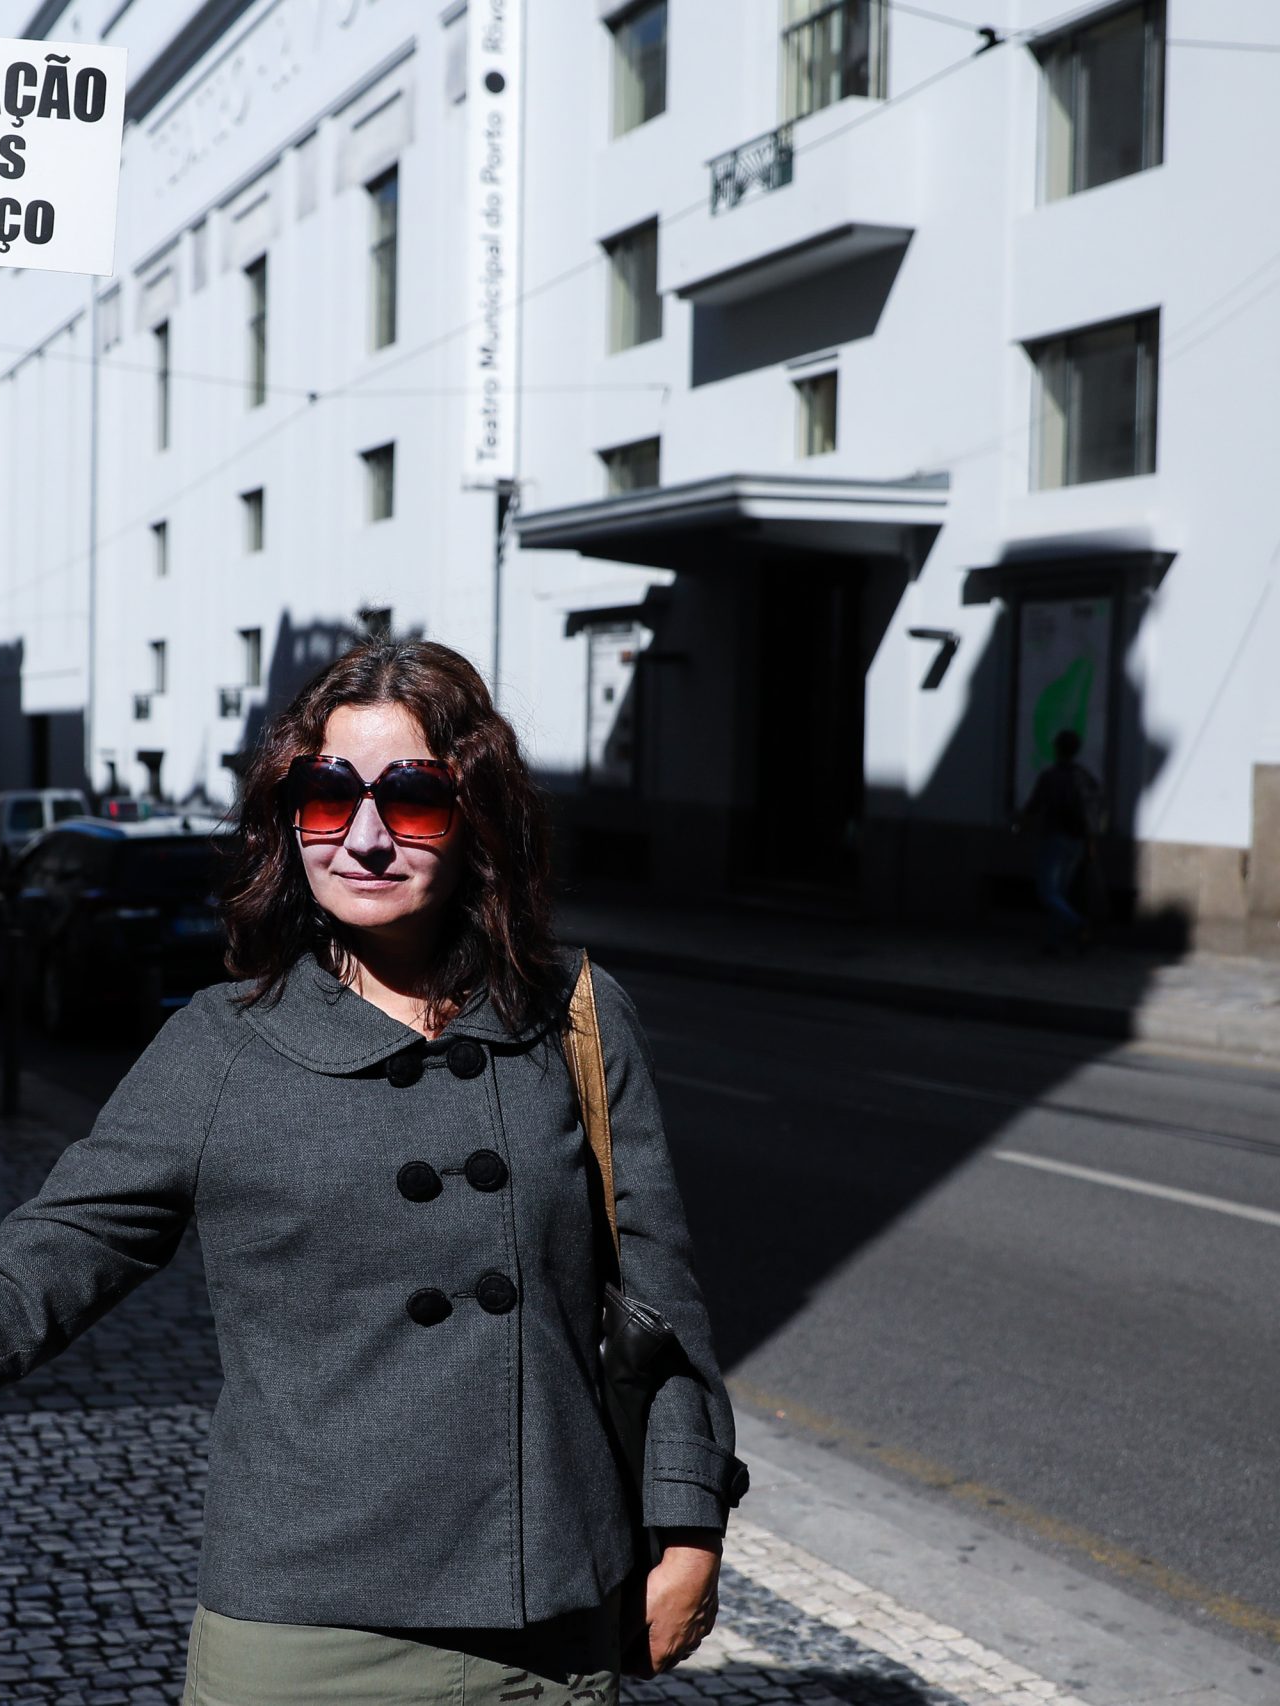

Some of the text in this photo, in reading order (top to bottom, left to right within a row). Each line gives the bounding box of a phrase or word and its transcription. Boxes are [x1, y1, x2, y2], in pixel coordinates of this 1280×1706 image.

[480, 112, 502, 184] Porto
[483, 194, 502, 226] do
[478, 236, 503, 370] Municipal
[476, 378, 501, 464] Teatro
